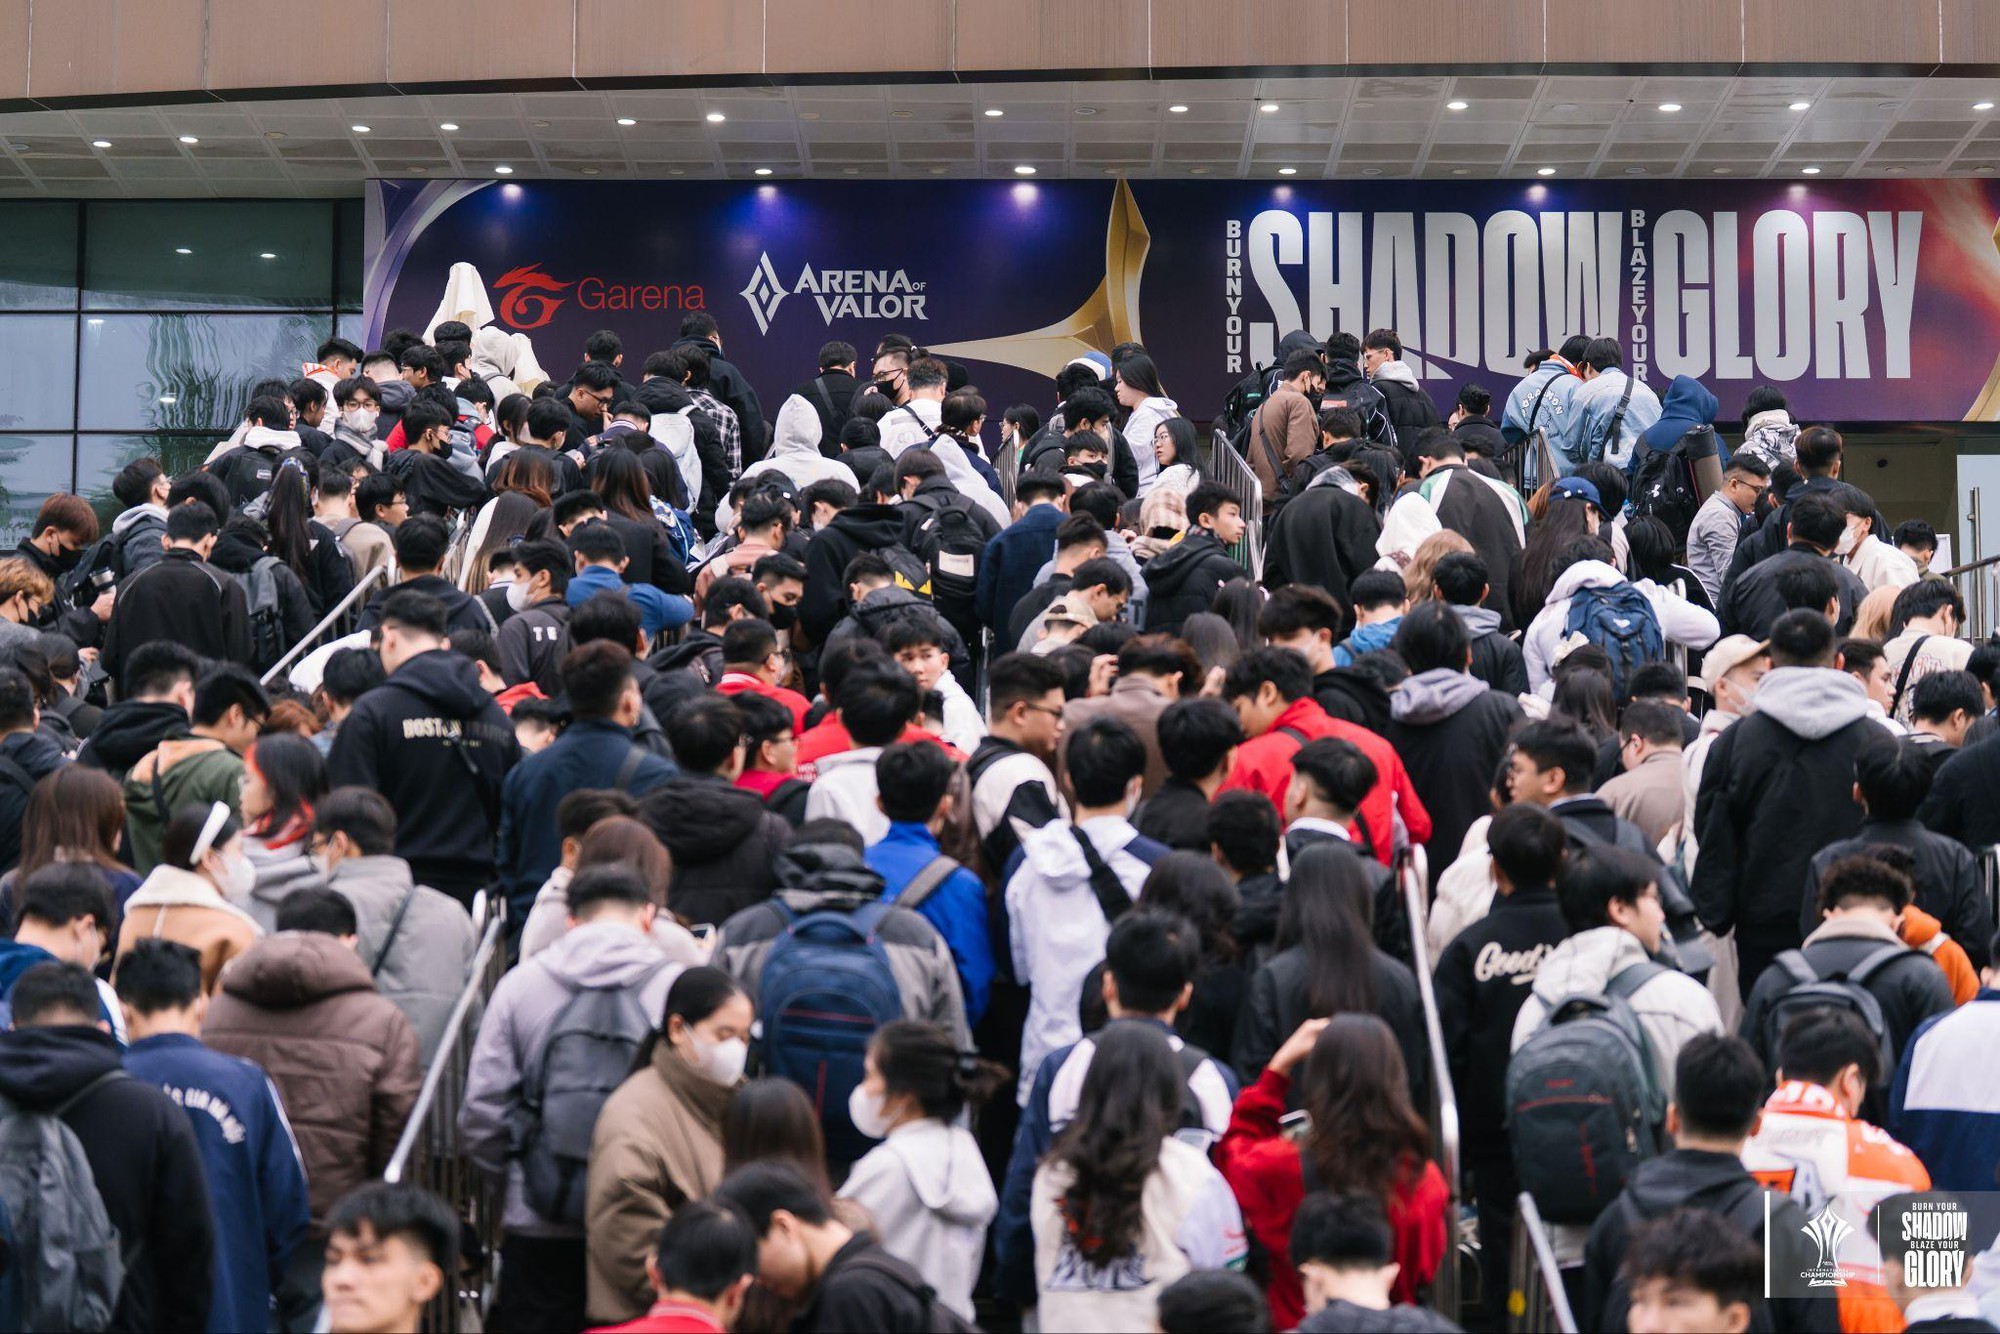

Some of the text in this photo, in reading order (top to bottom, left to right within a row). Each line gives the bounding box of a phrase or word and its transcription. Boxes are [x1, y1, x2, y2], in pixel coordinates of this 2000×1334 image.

[577, 277, 705, 311] Garena
[793, 262, 926, 294] ARENA OF
[1248, 209, 1623, 380] SHADOW
[812, 294, 930, 327] VALOR
[1652, 209, 1924, 382] GLORY
